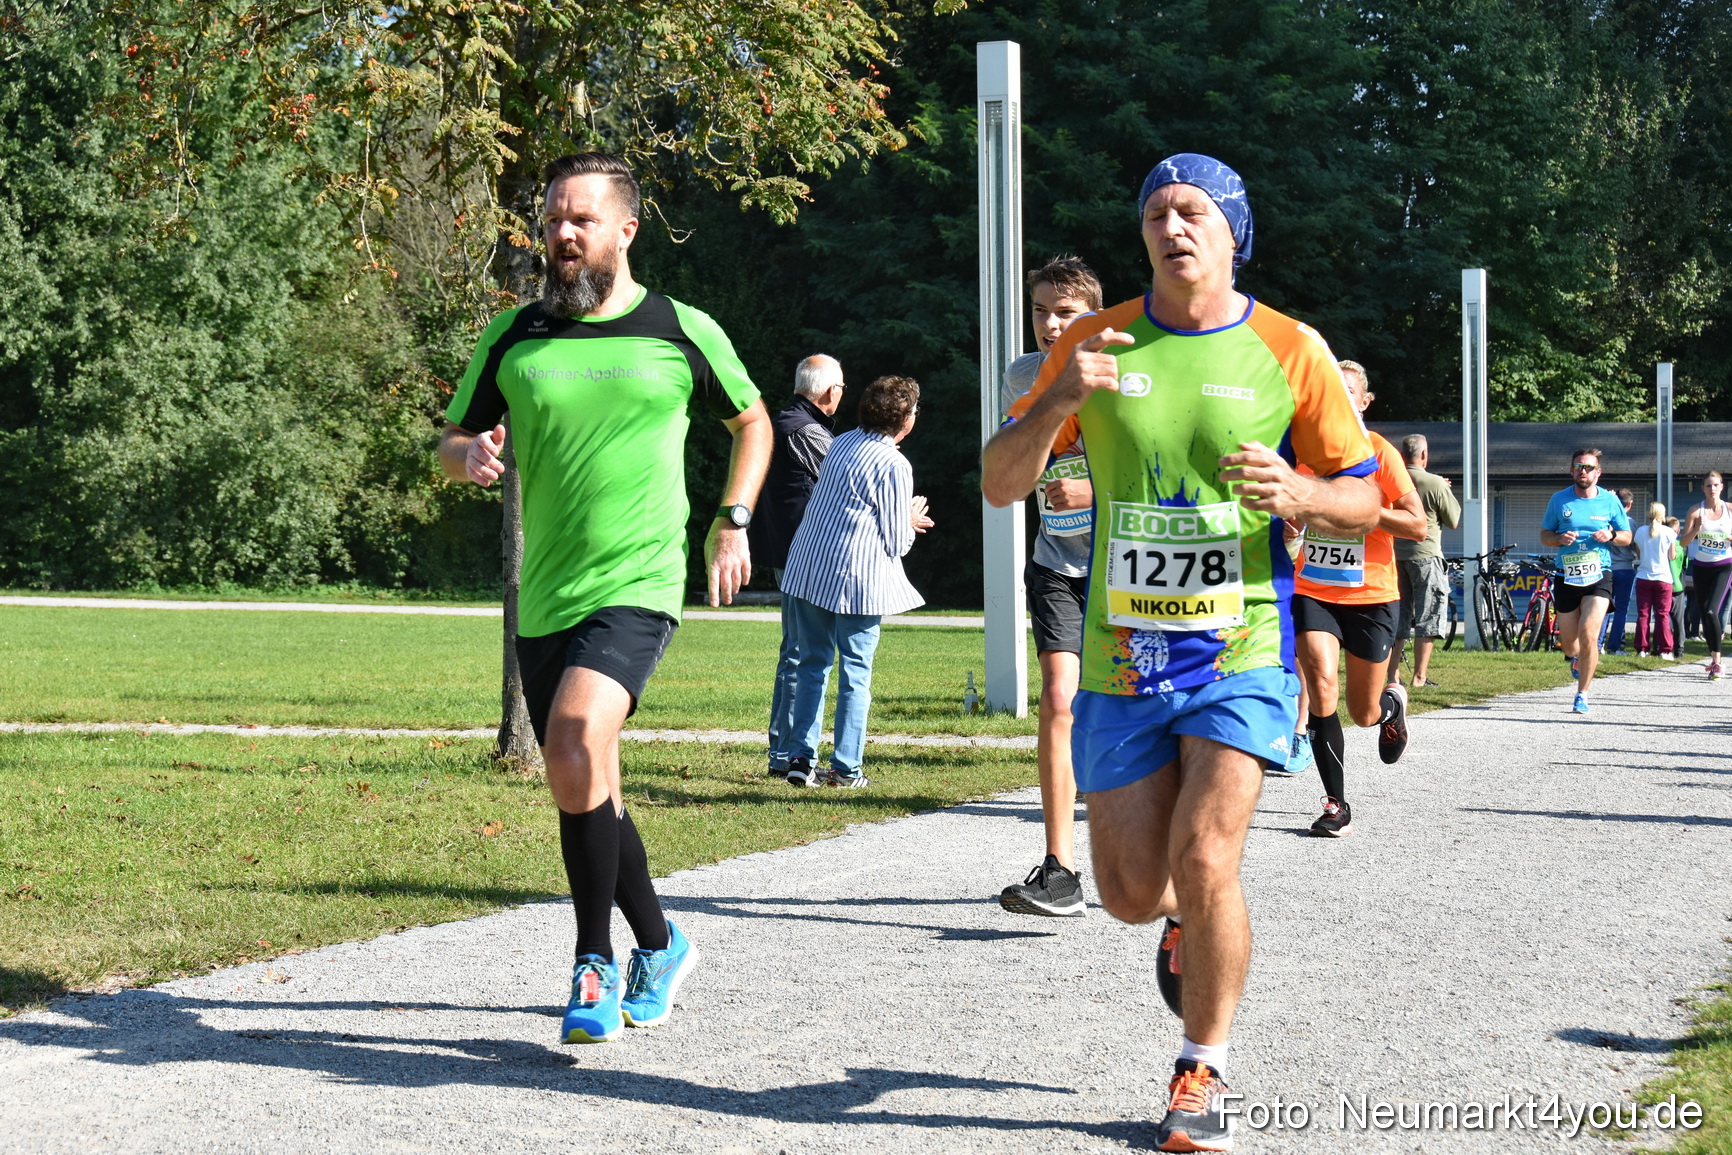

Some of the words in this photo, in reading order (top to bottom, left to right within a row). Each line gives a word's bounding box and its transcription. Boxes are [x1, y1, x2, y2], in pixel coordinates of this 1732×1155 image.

[527, 365, 660, 383] Dorfner-Apotheken
[1202, 384, 1255, 400] BOCK
[1041, 461, 1089, 481] OCK
[1046, 513, 1091, 528] KORBINI
[1119, 508, 1228, 540] BOCK
[1701, 538, 1724, 549] 2299
[1308, 544, 1356, 566] 2754
[1122, 549, 1227, 588] 1278
[1567, 563, 1597, 577] 2550
[1130, 598, 1215, 616] NIKOLAI
